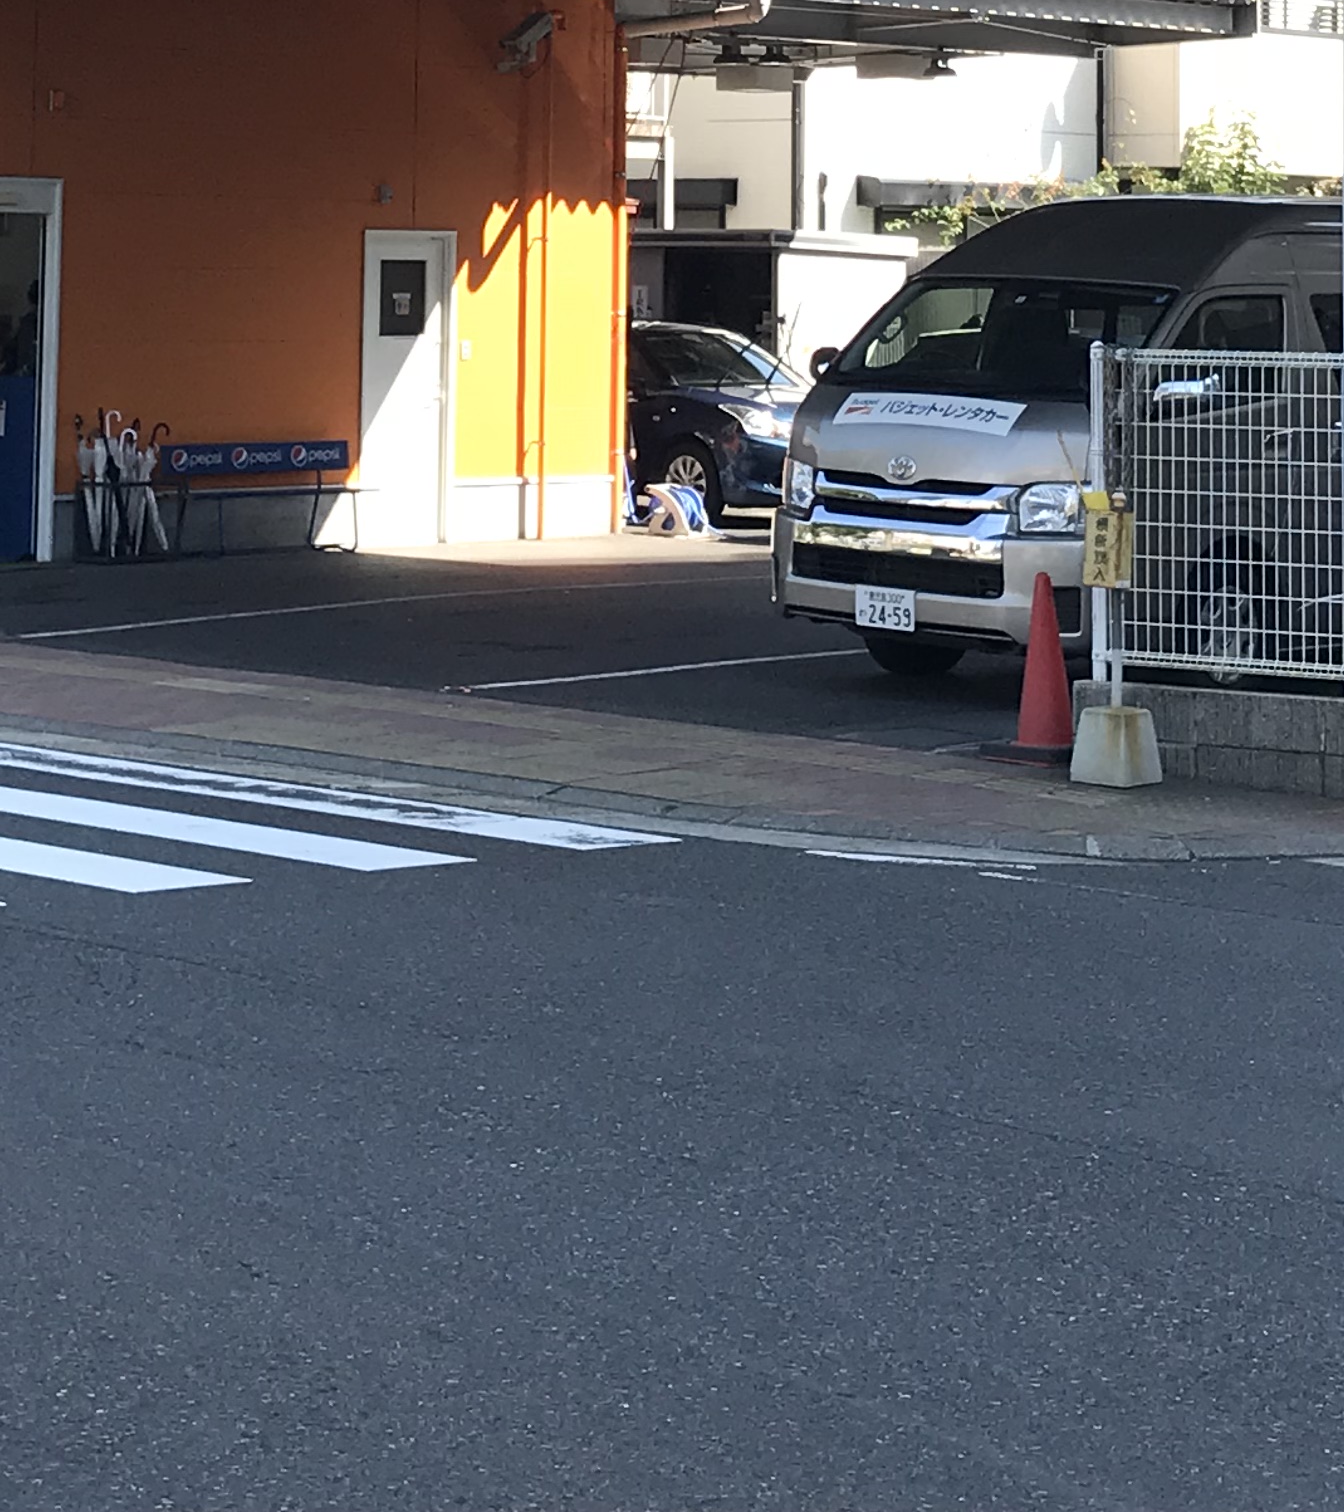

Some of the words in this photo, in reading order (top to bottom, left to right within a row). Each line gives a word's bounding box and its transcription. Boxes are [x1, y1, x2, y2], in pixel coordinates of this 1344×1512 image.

[189, 451, 223, 468] pepsi
[249, 449, 283, 465] pepsi
[308, 447, 341, 463] pepsi
